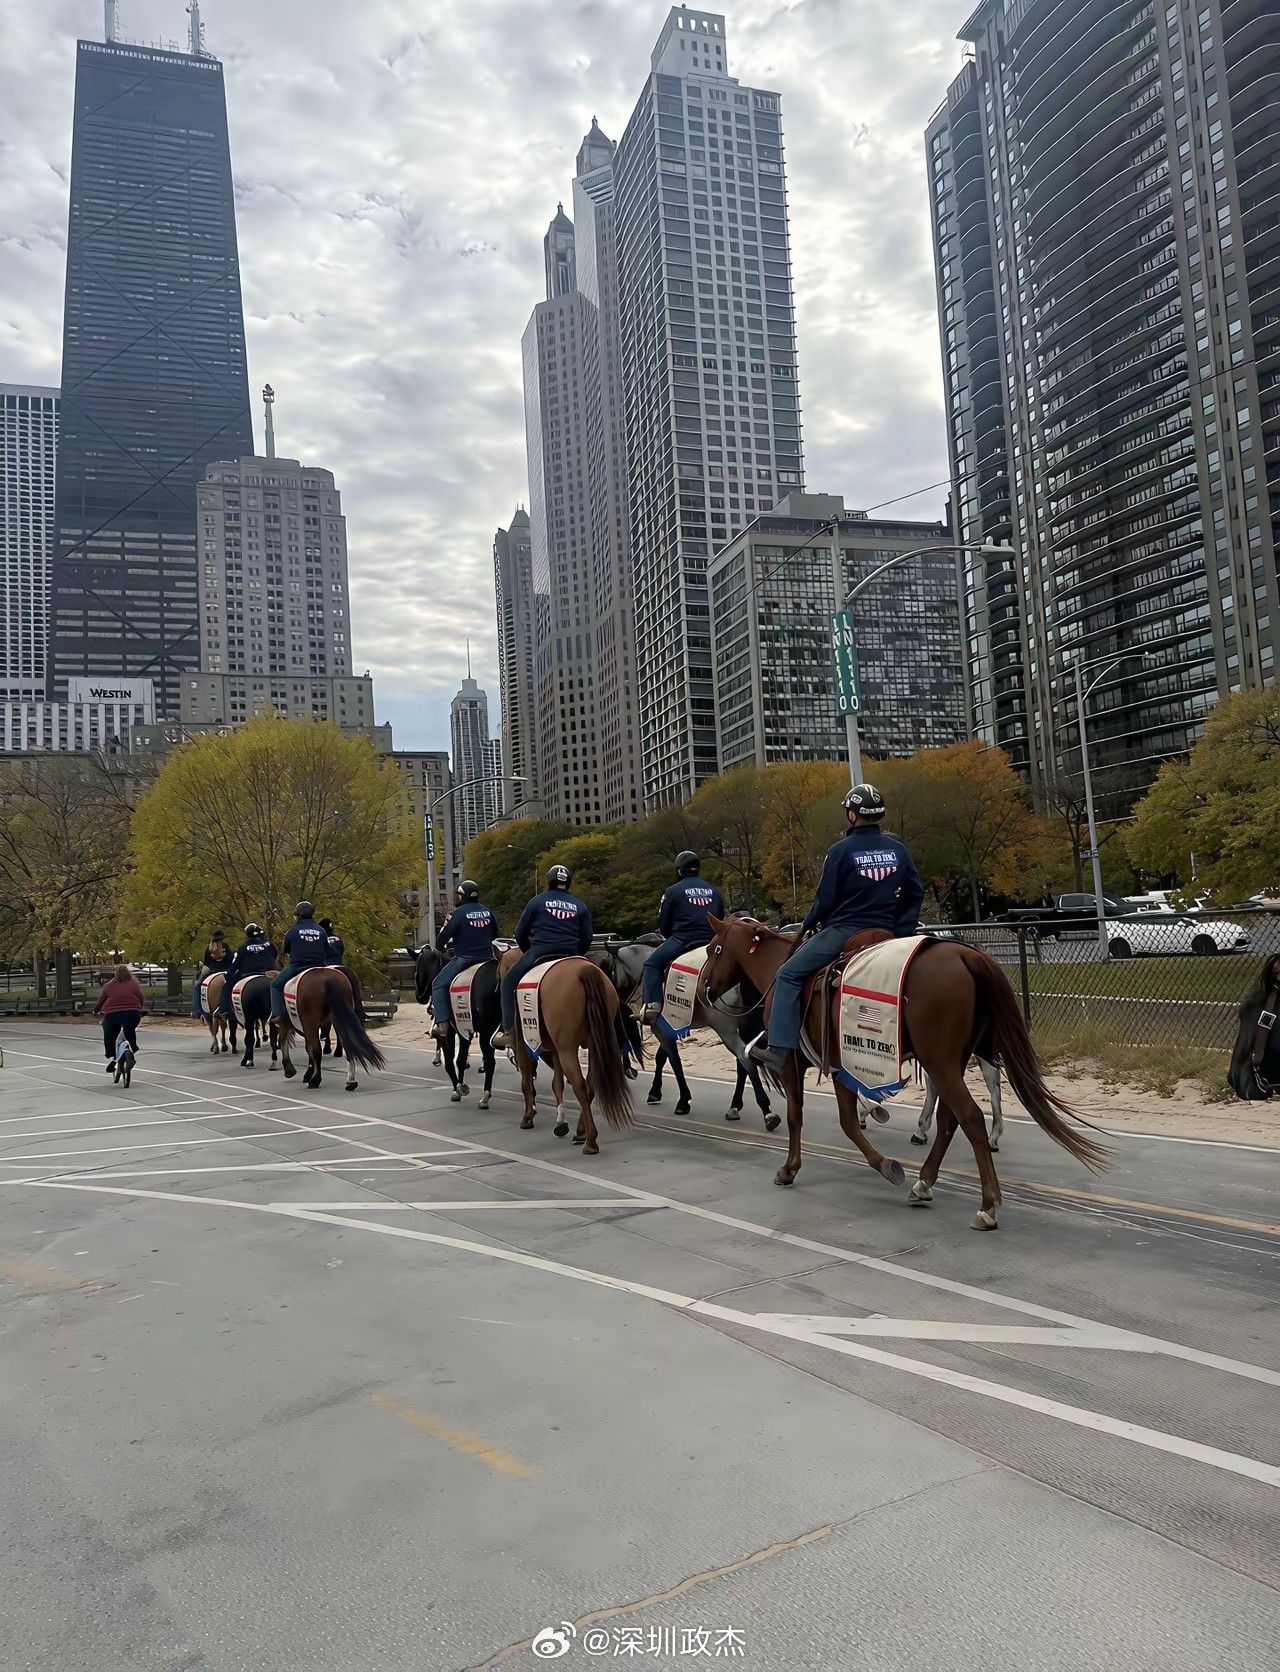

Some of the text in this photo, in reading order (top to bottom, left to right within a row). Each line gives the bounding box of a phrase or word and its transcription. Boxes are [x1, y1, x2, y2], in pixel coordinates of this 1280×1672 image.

[89, 688, 131, 698] WESTIN
[855, 855, 873, 864] TRAIL
[873, 854, 882, 862] TO
[882, 852, 896, 861] ZERO
[843, 1034, 895, 1055] TRAIL TO ZERO
